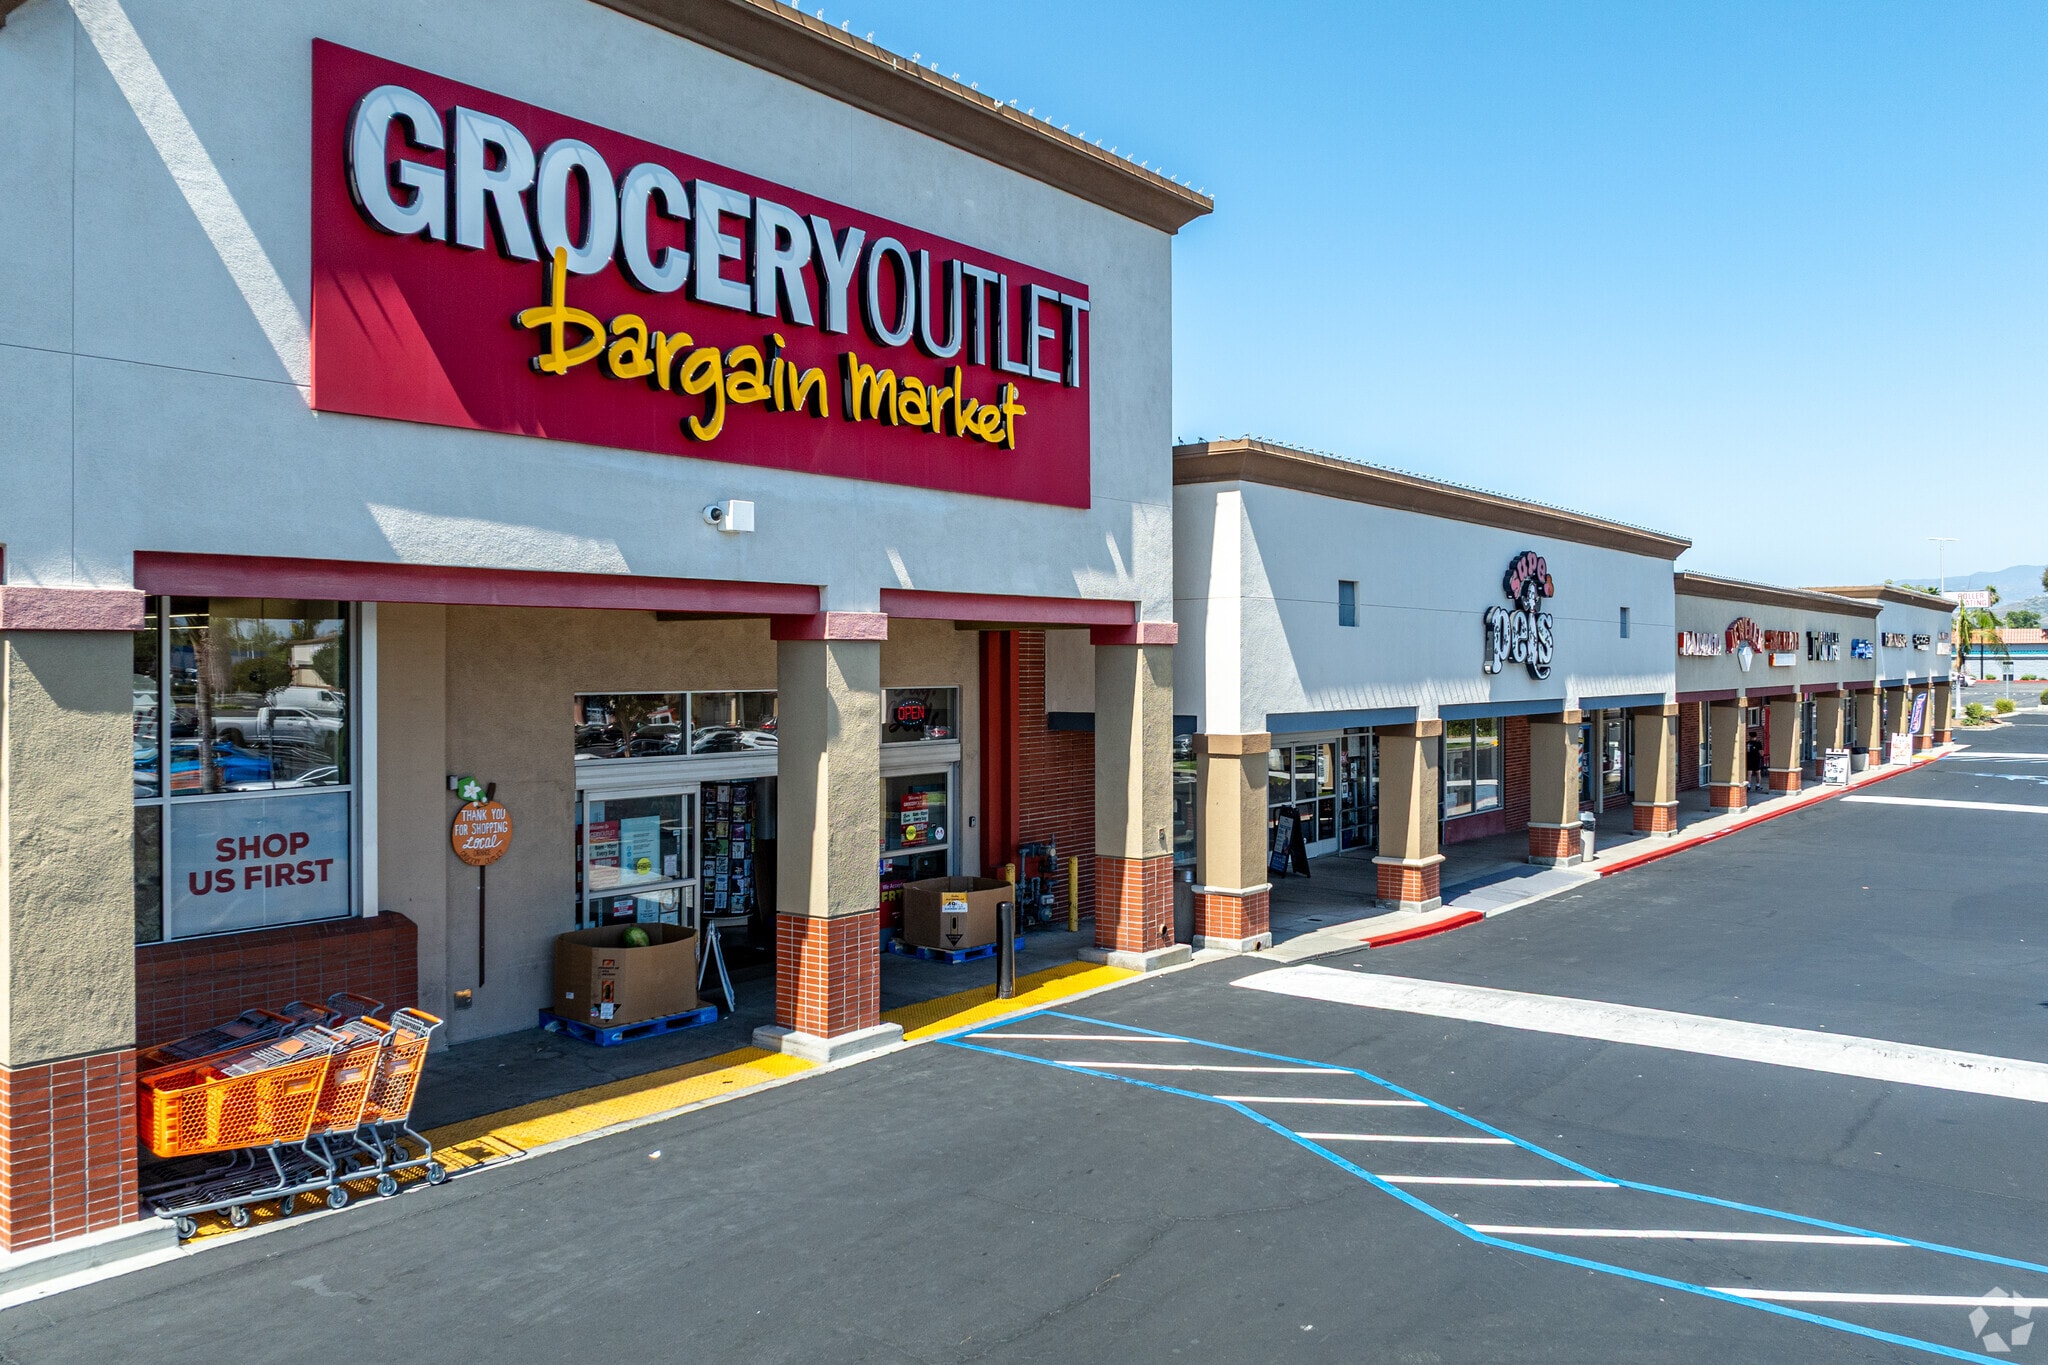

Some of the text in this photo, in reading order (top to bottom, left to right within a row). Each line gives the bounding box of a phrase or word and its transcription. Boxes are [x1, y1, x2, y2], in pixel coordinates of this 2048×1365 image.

[840, 351, 1027, 451] market
[897, 705, 925, 721] OPEN
[461, 808, 506, 821] THANK YOU
[455, 821, 508, 836] FOR SHOPPING
[215, 831, 310, 863] SHOP
[462, 834, 503, 849] Local
[188, 858, 334, 896] US FIRST
